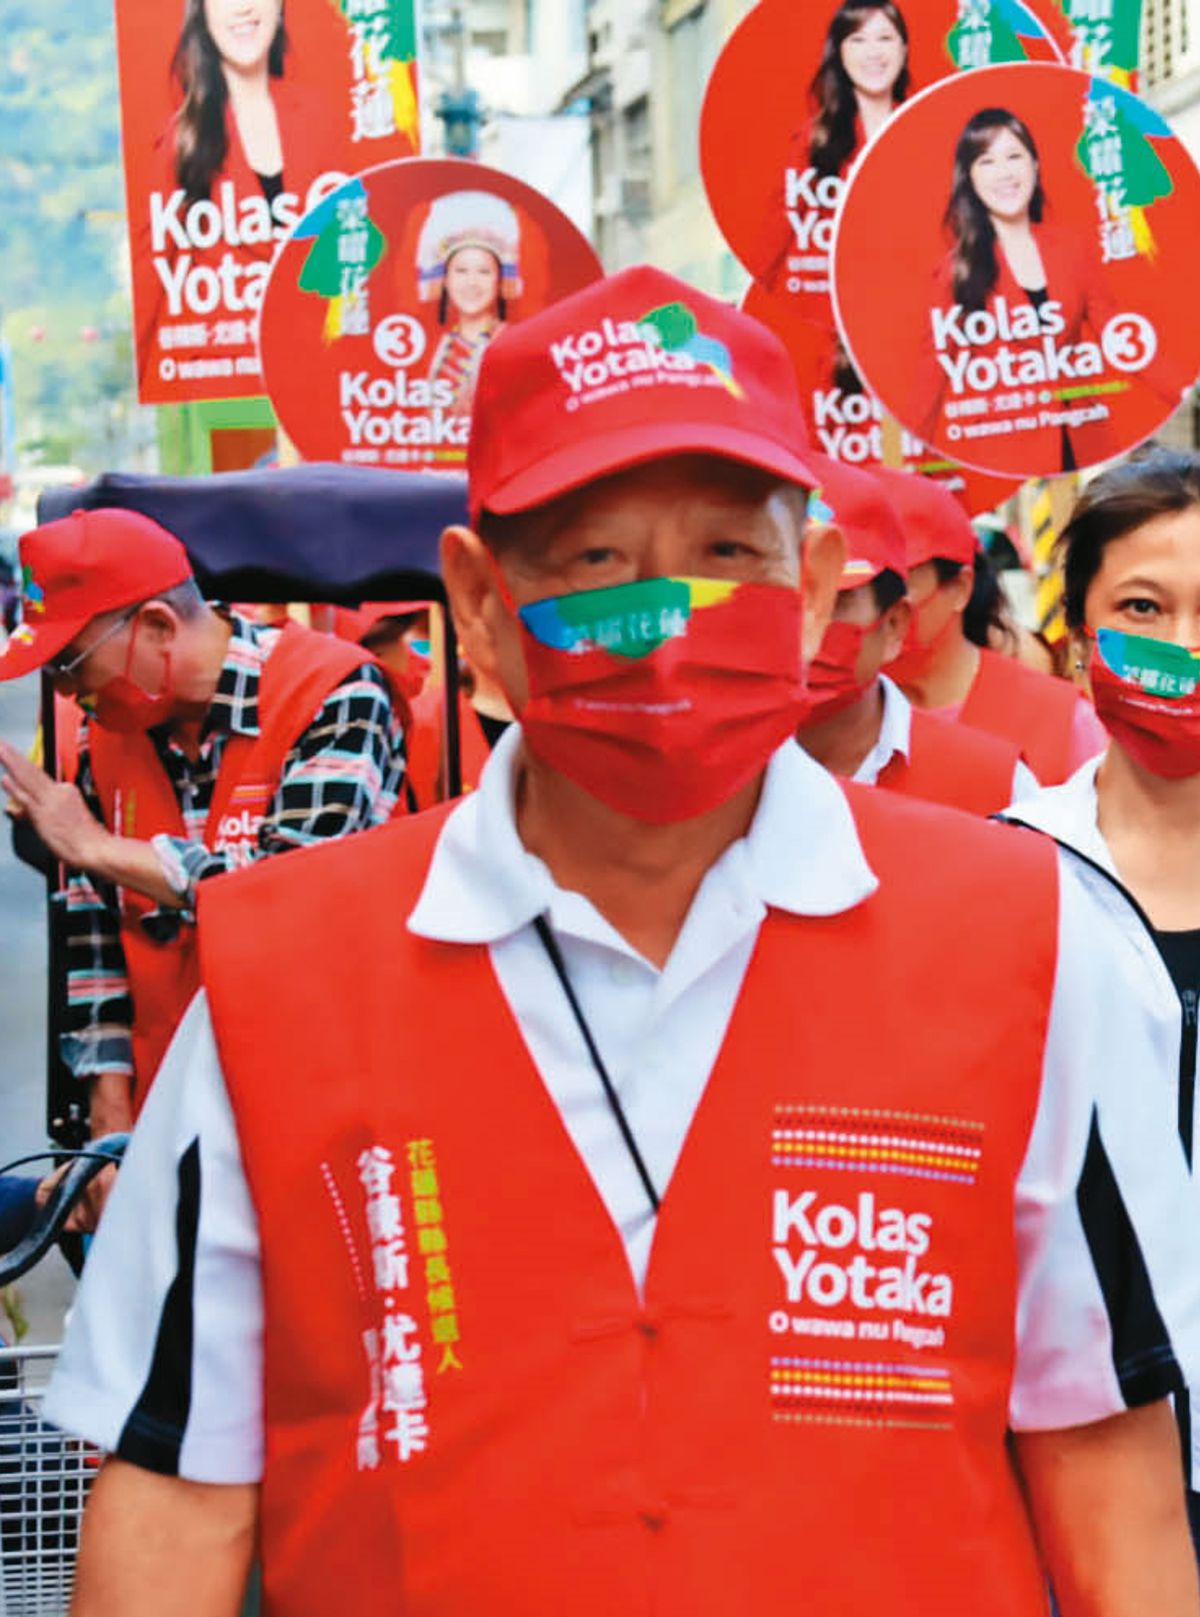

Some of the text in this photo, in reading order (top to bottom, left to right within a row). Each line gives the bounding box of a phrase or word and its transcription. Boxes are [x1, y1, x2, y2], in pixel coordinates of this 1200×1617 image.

[150, 181, 299, 252] Kolas
[383, 320, 418, 362] 3
[550, 317, 663, 368] Kolas
[930, 296, 1066, 350] Kolas
[1111, 318, 1149, 366] 3
[159, 356, 176, 381] O
[339, 369, 454, 408] Kolas
[561, 342, 696, 392] Yotaka
[937, 336, 1104, 394] Yotaka
[946, 424, 962, 441] O
[772, 1188, 933, 1257] Kolas
[772, 1247, 953, 1317] Yotaka
[768, 1310, 789, 1335] O
[791, 1316, 855, 1339] wawa
[858, 1321, 889, 1340] nu
